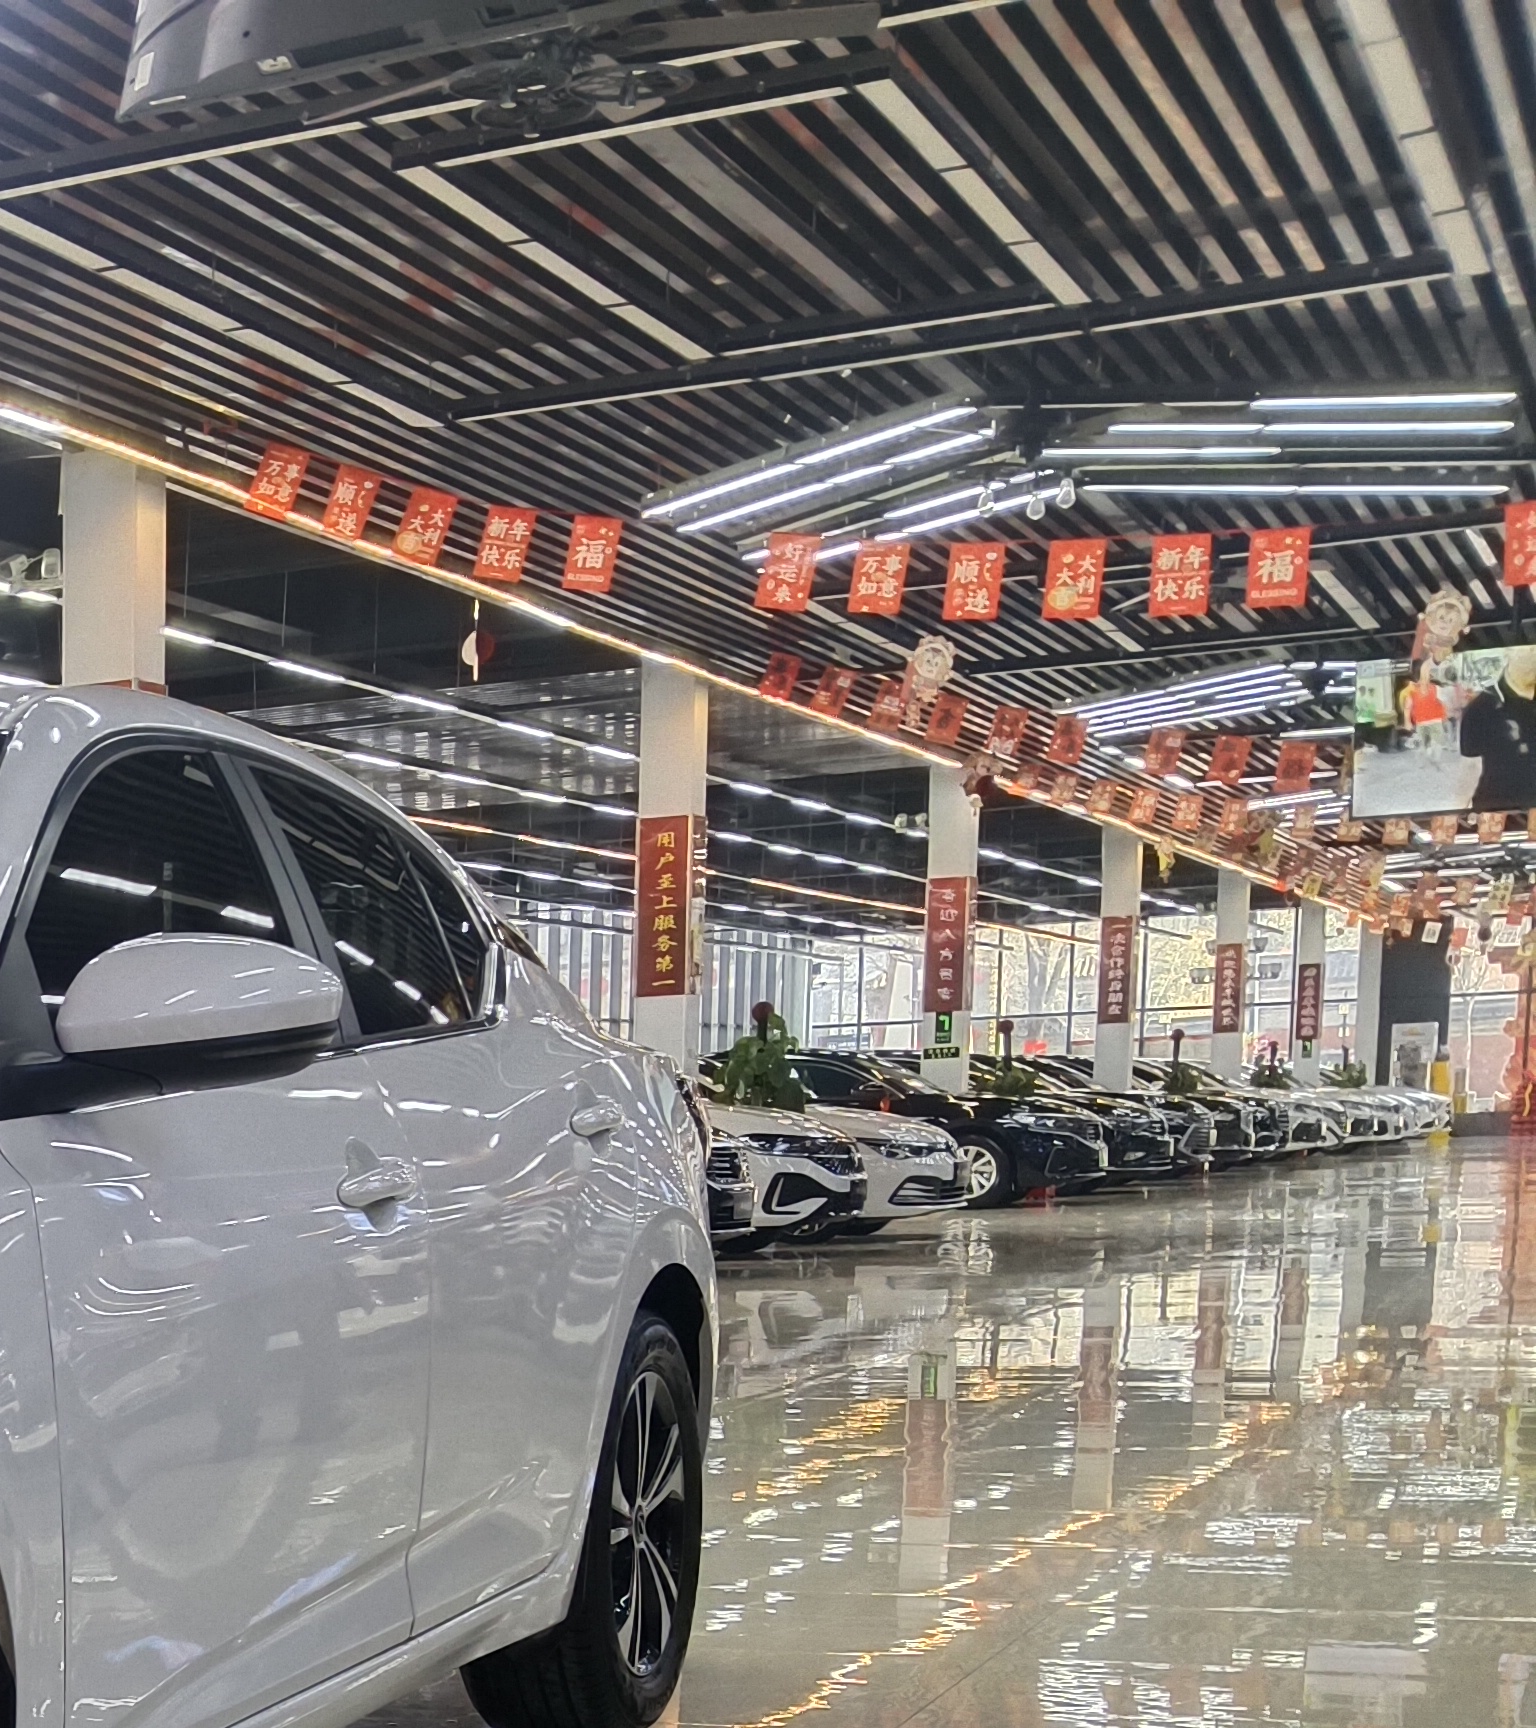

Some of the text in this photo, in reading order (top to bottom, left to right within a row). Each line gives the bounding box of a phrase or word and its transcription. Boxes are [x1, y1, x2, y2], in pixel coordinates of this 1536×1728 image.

[265, 459, 302, 482] 万事
[487, 516, 530, 542] 新年
[481, 545, 522, 570] 快乐
[572, 537, 608, 569] 福
[861, 555, 902, 576] 万事
[1156, 545, 1210, 570] 新年
[1253, 550, 1295, 584] 福
[857, 576, 899, 598] 如意
[1153, 576, 1206, 602] 快乐
[651, 831, 678, 986] 用户至上服务第一
